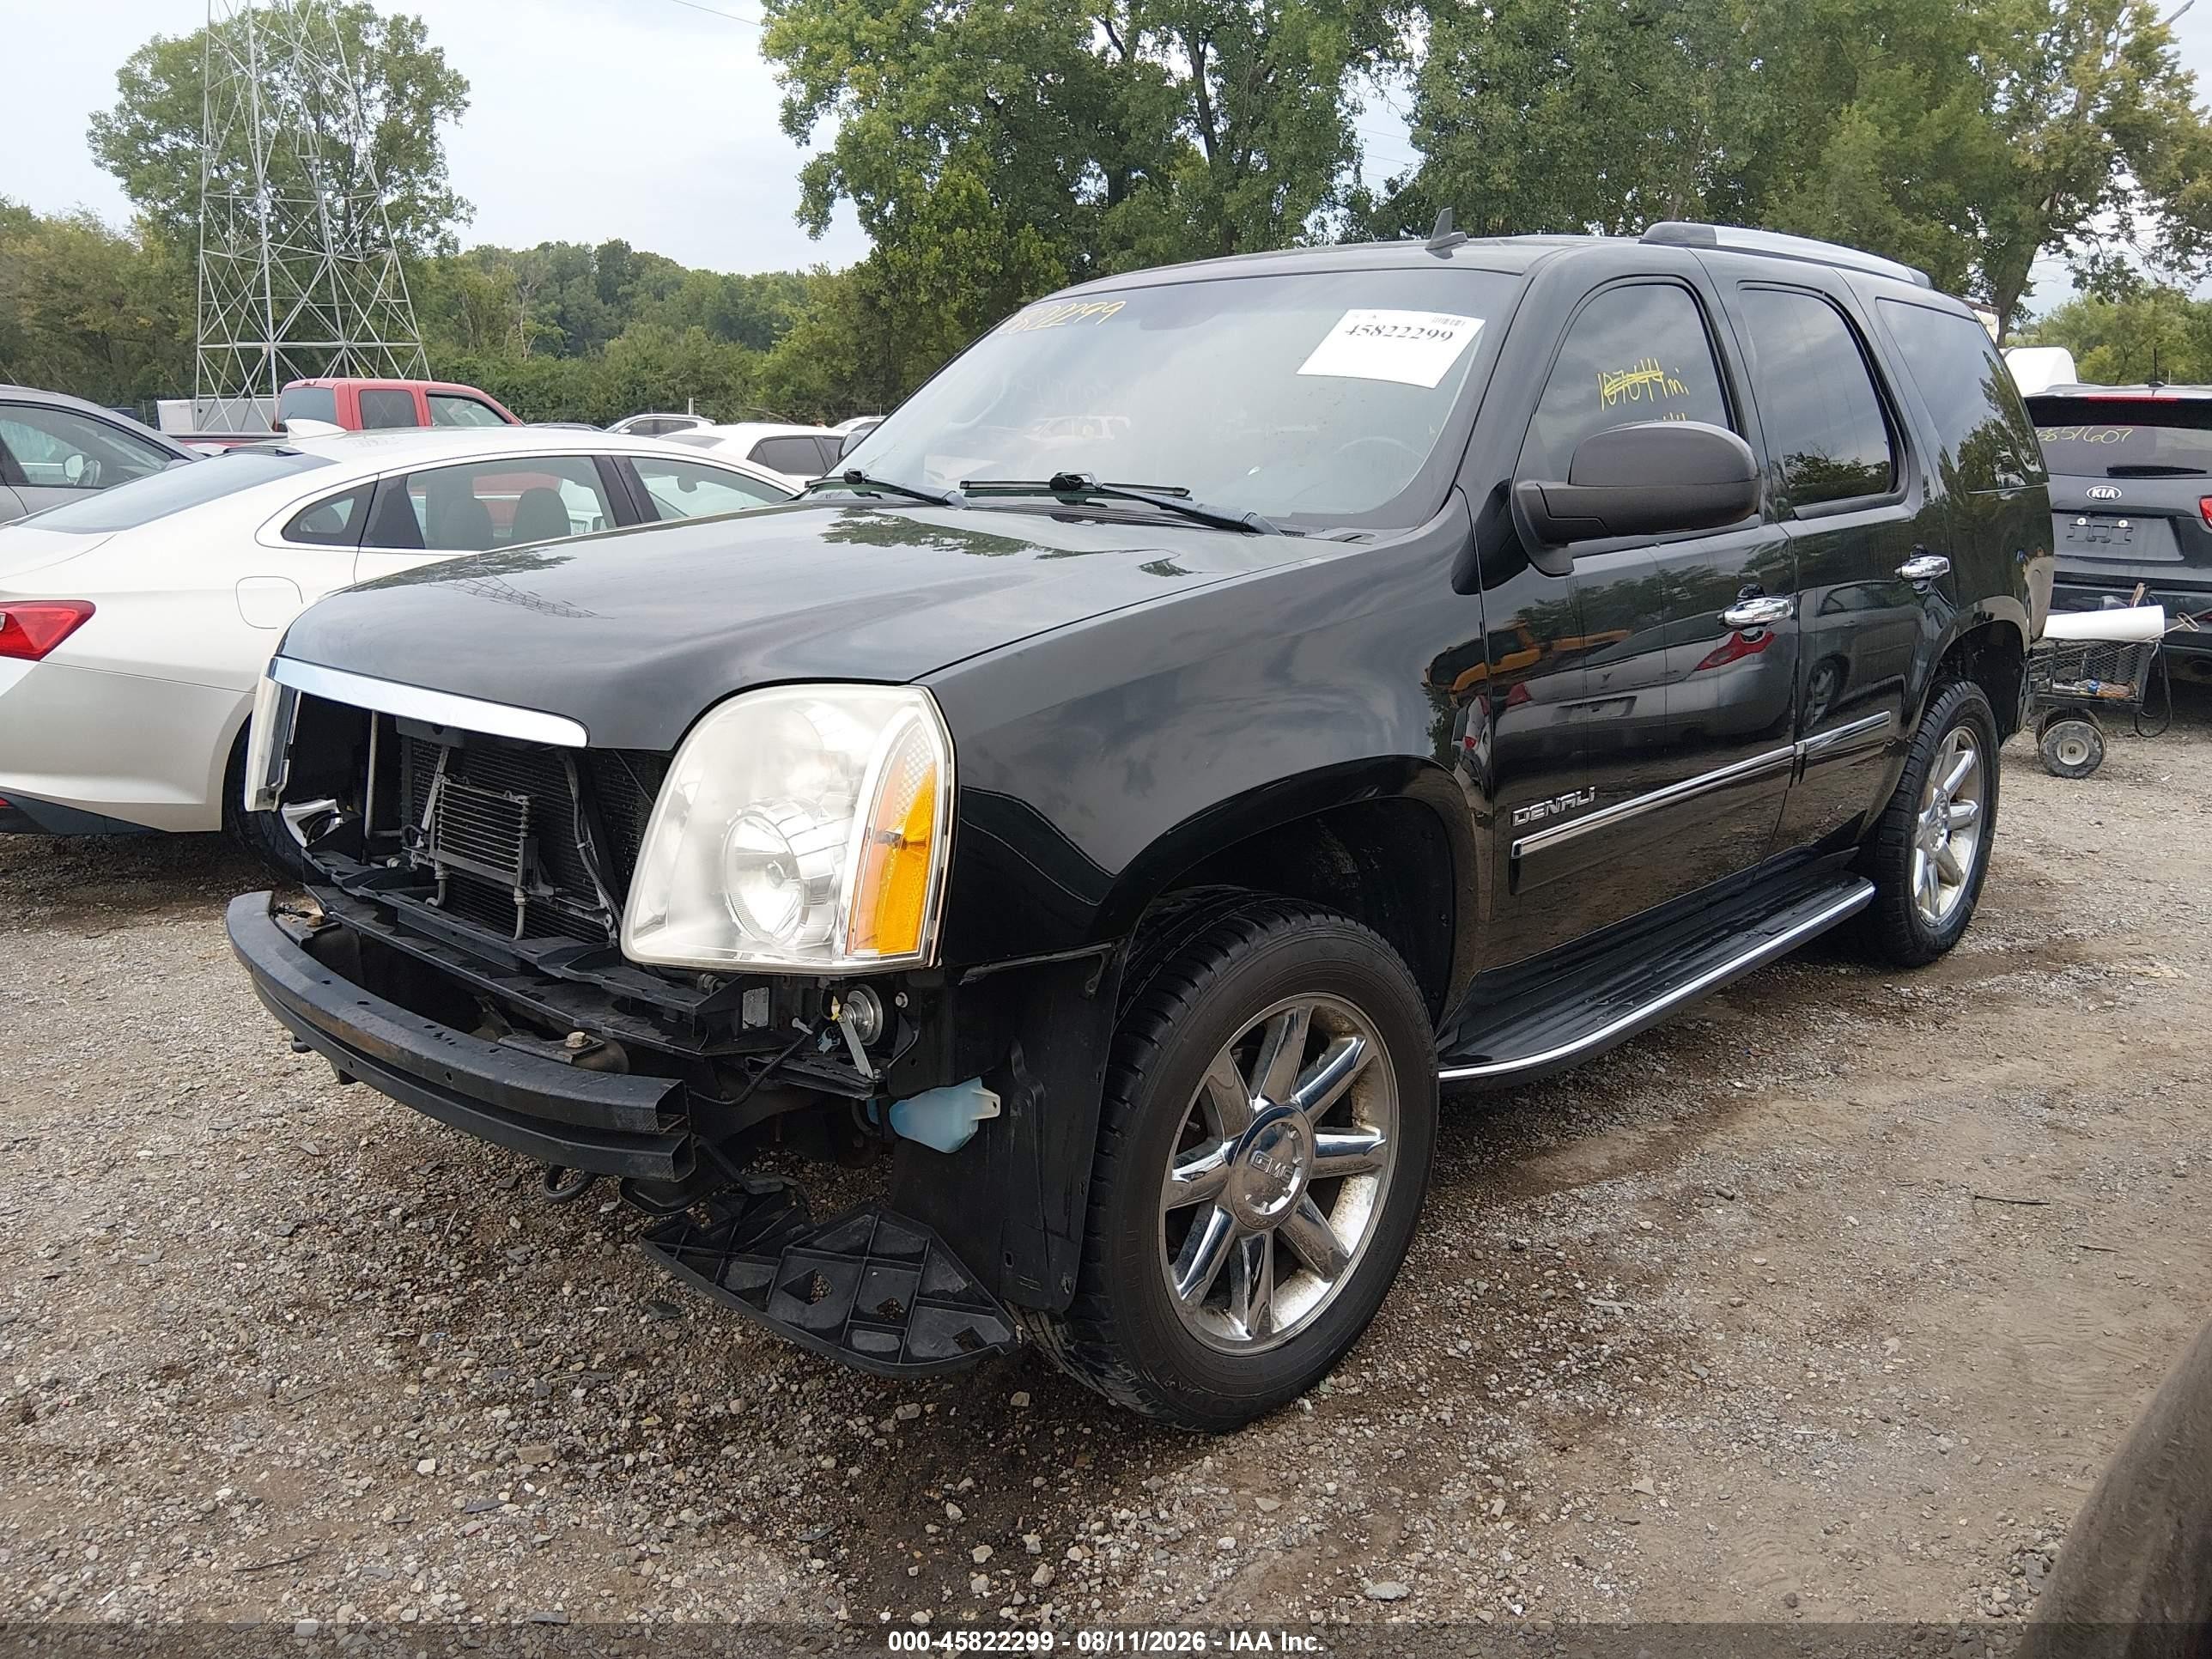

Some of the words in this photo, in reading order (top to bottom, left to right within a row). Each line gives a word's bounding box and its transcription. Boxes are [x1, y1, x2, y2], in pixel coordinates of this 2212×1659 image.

[1345, 324, 1454, 343] 45822299
[2090, 488, 2118, 499] KIA
[1512, 786, 1595, 827] DENALI
[1250, 1150, 1294, 1183] GMC
